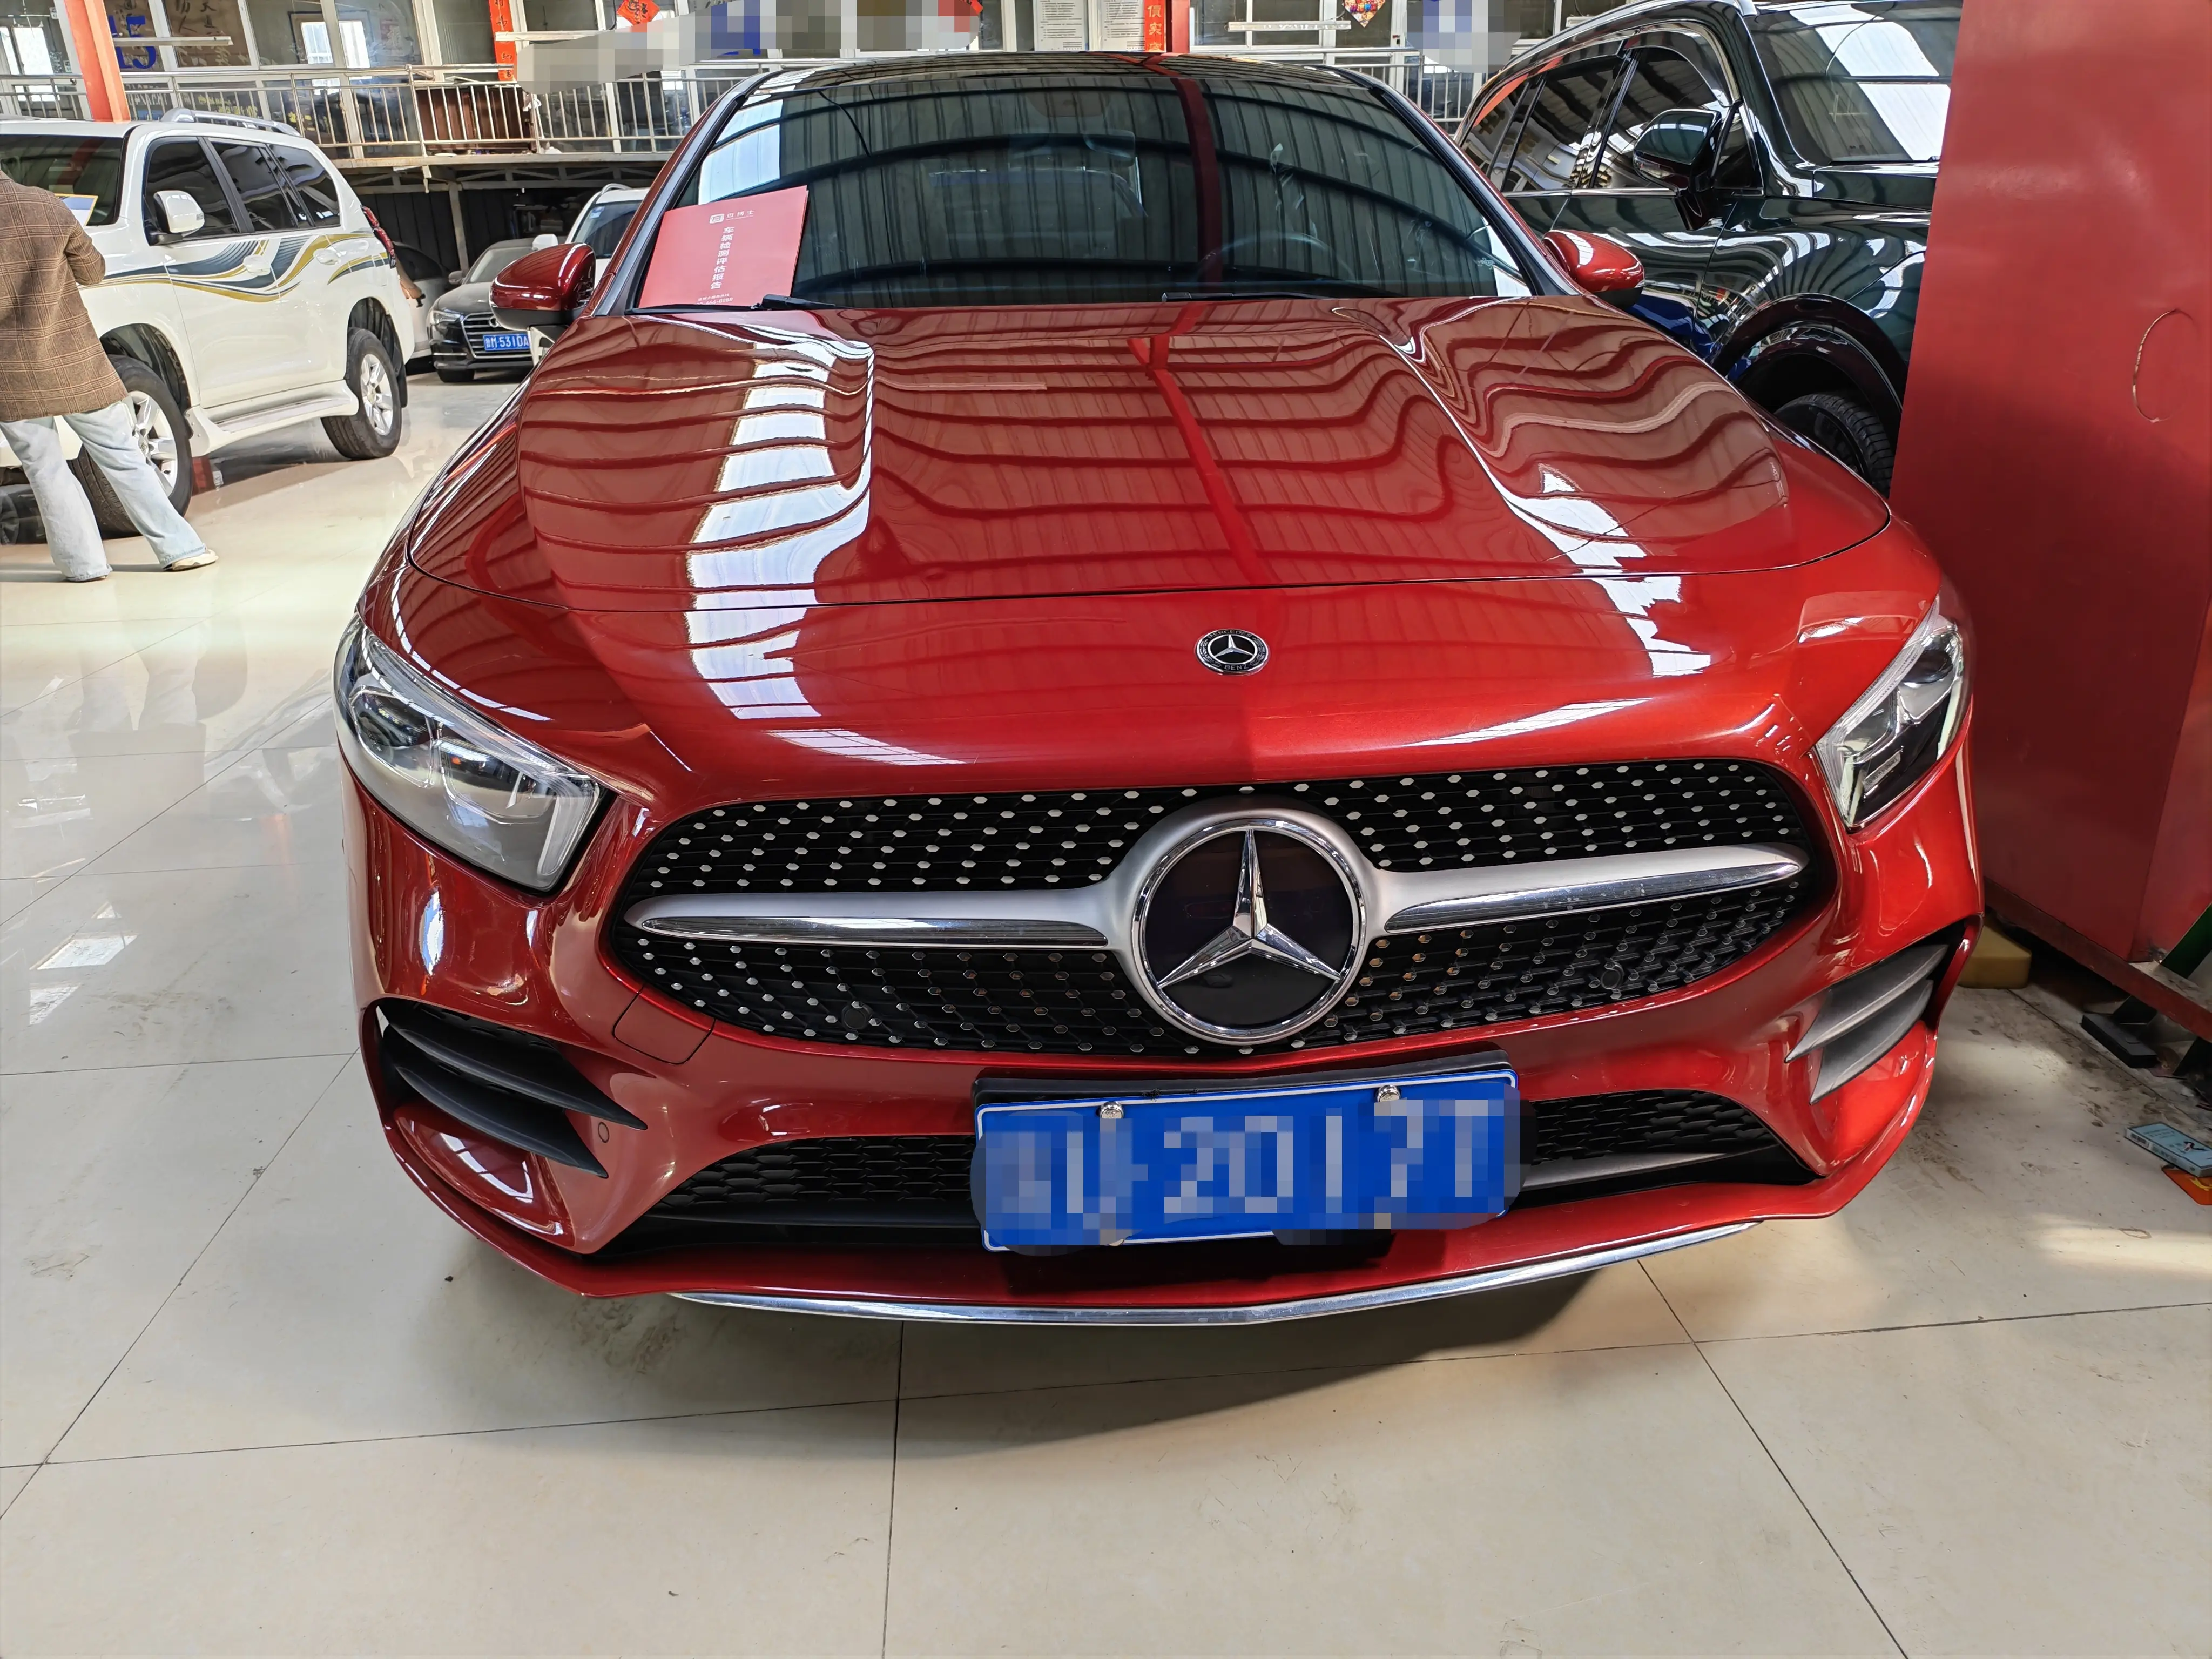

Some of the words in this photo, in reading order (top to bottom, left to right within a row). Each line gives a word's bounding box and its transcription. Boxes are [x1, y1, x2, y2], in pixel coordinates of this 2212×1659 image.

[710, 226, 735, 289] 车辆检测评估报告
[1207, 630, 1252, 639] MERCEDES
